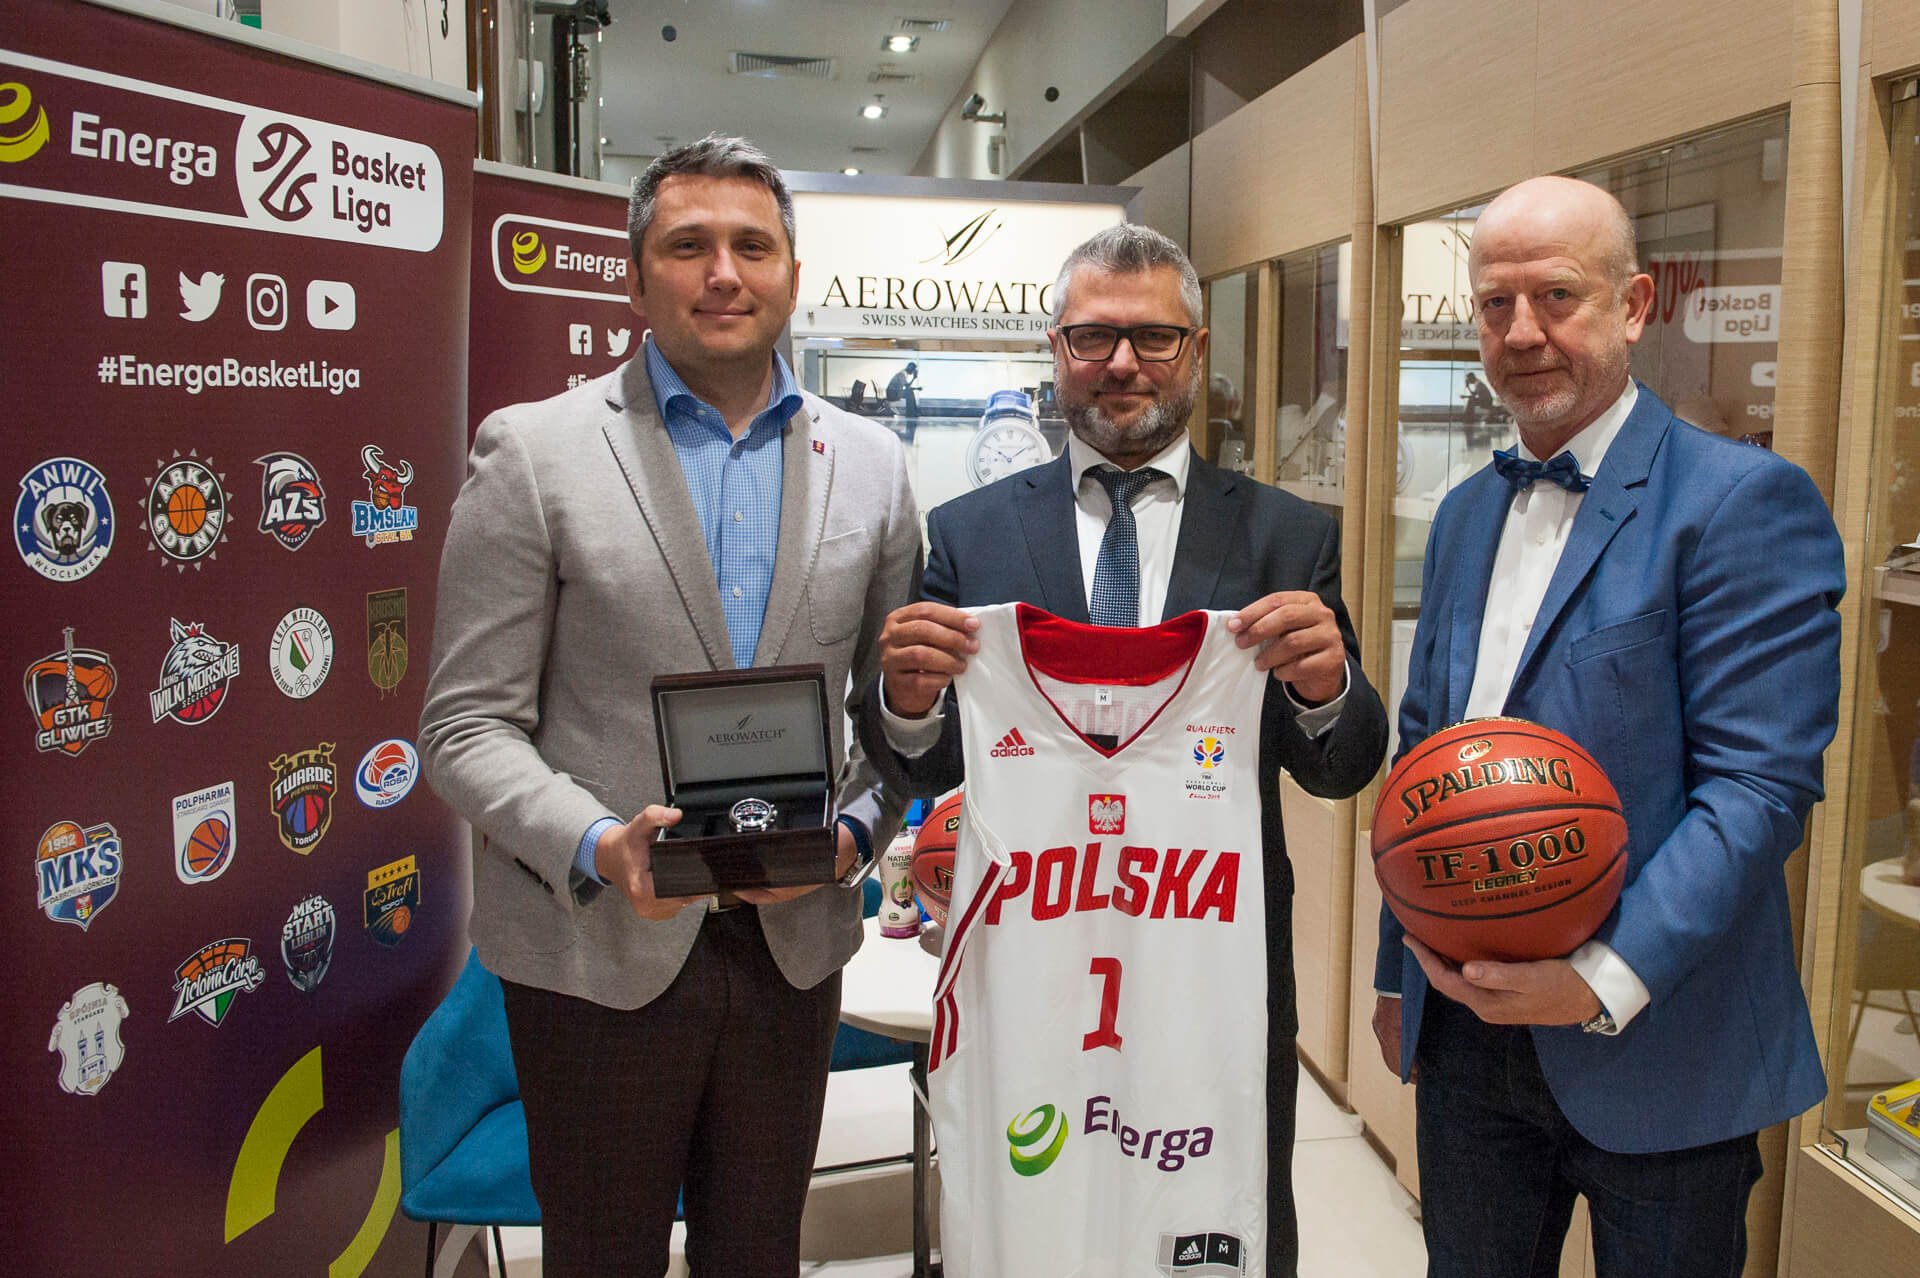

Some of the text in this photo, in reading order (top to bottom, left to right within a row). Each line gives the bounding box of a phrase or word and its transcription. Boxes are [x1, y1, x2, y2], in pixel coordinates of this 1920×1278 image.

[71, 112, 217, 186] Energa
[331, 140, 427, 192] Basket
[331, 185, 391, 233] Liga
[555, 244, 627, 282] Energa
[862, 314, 1053, 331] SWISS WATCHES SINCE 191
[97, 355, 360, 395] #EnergaBasketLiga
[28, 463, 100, 500] ANWIL
[157, 465, 214, 504] ARKA
[264, 492, 321, 526] AZS
[154, 509, 221, 555] GDYNIA
[54, 704, 89, 725] GTK
[153, 681, 185, 719] WILKI
[38, 720, 106, 748] GLIWICE
[706, 728, 782, 745] AEROWATCH
[990, 745, 1035, 758] adidas
[175, 786, 231, 811] POLPHARMA
[274, 766, 333, 801] TWARDE
[1185, 783, 1226, 792] WORLD CUP
[1400, 757, 1575, 827] SPALDING
[40, 841, 118, 901] MKS
[1416, 826, 1586, 882] TF-1000
[984, 842, 1241, 926] POLSKA
[1473, 868, 1539, 893] LEGACY
[283, 904, 333, 942] START
[293, 895, 322, 920] MKS
[291, 924, 327, 950] LUBLIN
[1082, 957, 1122, 1053] 1
[1083, 1095, 1214, 1173] Energa
[1218, 1243, 1229, 1254] M
